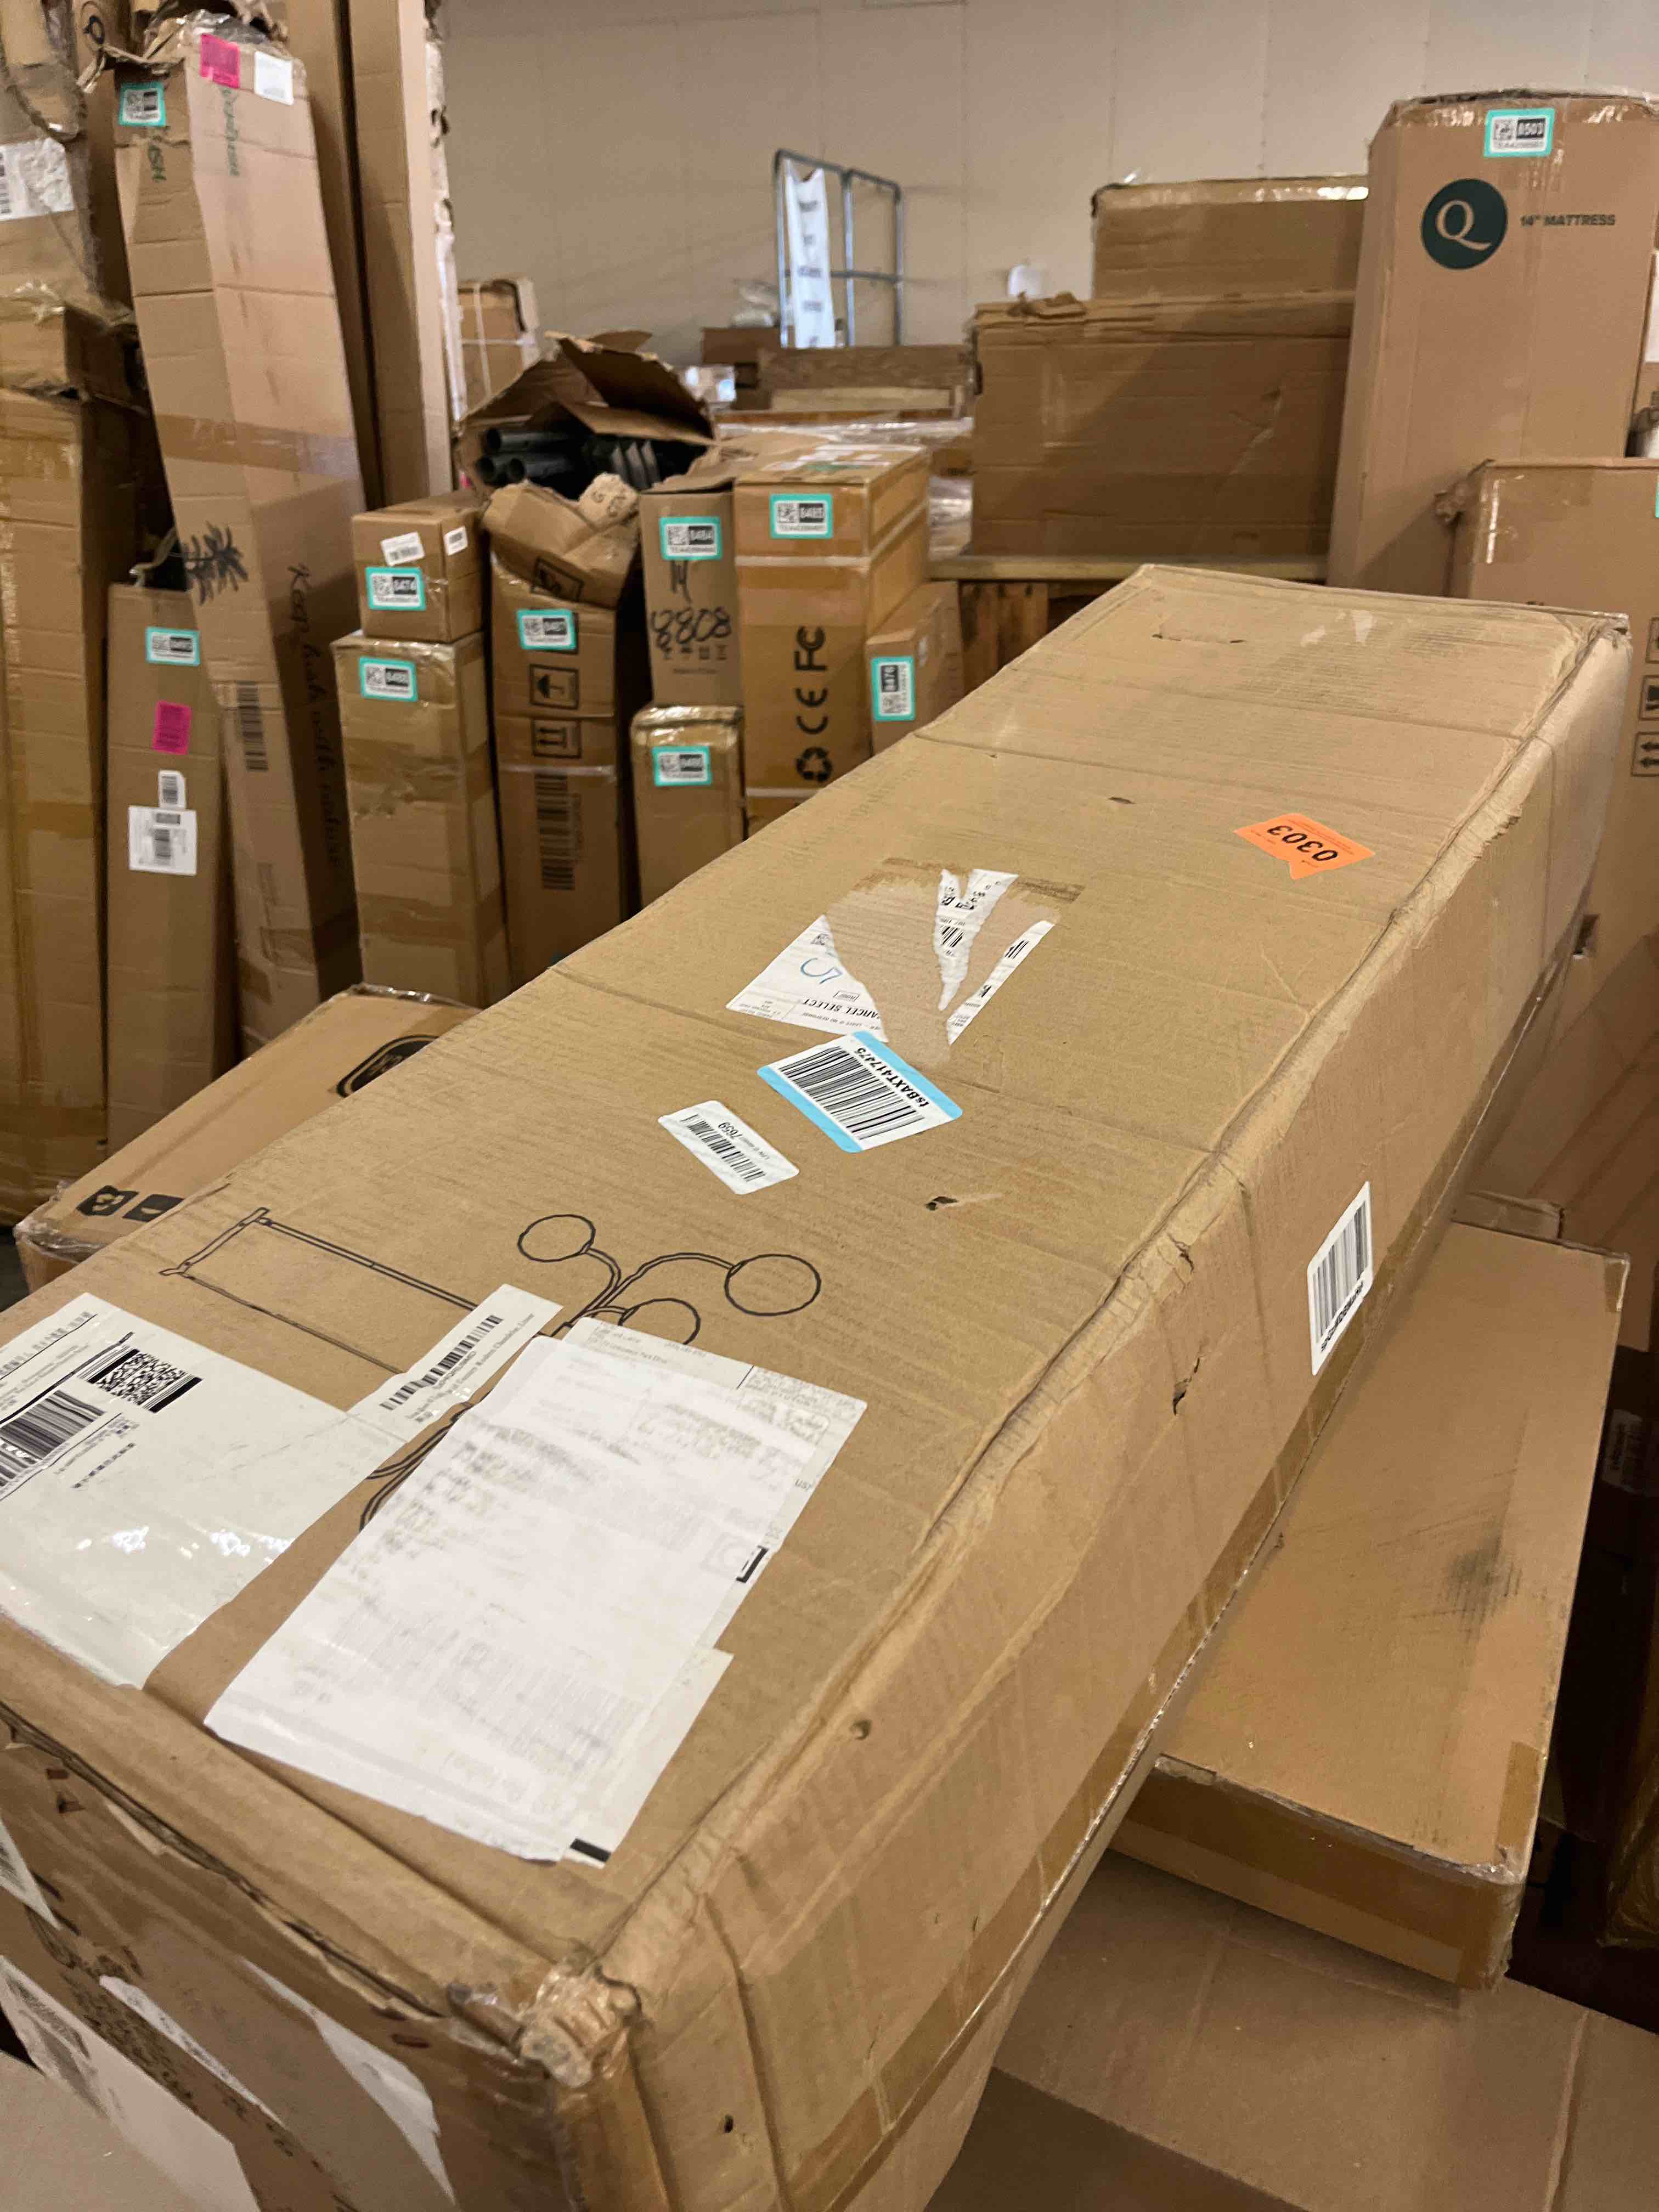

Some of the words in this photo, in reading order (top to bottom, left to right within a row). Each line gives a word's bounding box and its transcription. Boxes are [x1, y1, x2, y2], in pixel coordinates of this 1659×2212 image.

[1435, 200, 1492, 251] Q
[1544, 214, 1616, 226] MATTRESS
[1267, 825, 1338, 861] 0303
[803, 997, 843, 1012] SELECT
[845, 1006, 881, 1019] ARCEL
